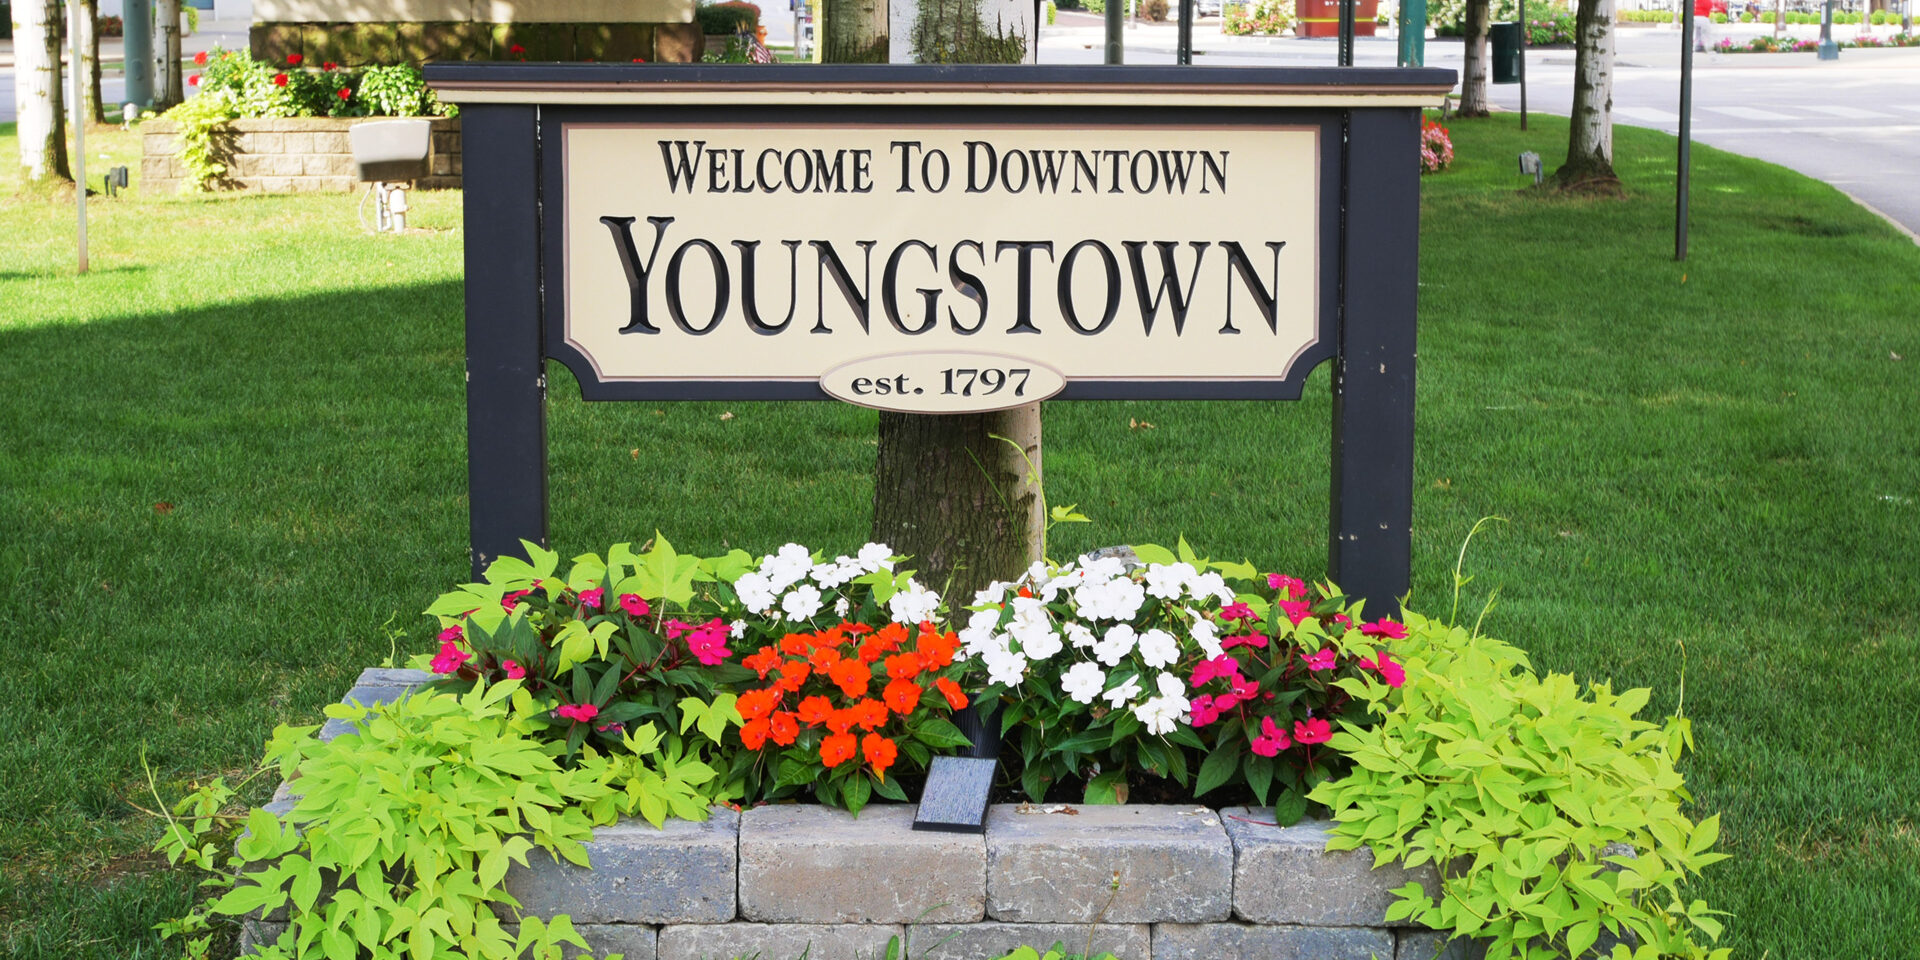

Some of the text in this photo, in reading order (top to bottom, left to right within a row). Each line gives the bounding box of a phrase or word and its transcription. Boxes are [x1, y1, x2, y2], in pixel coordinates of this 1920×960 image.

[657, 140, 1230, 195] WELCOME TO DOWNTOWN
[599, 215, 1287, 337] YOUNGSTOWN
[849, 368, 1032, 397] est. 1797
